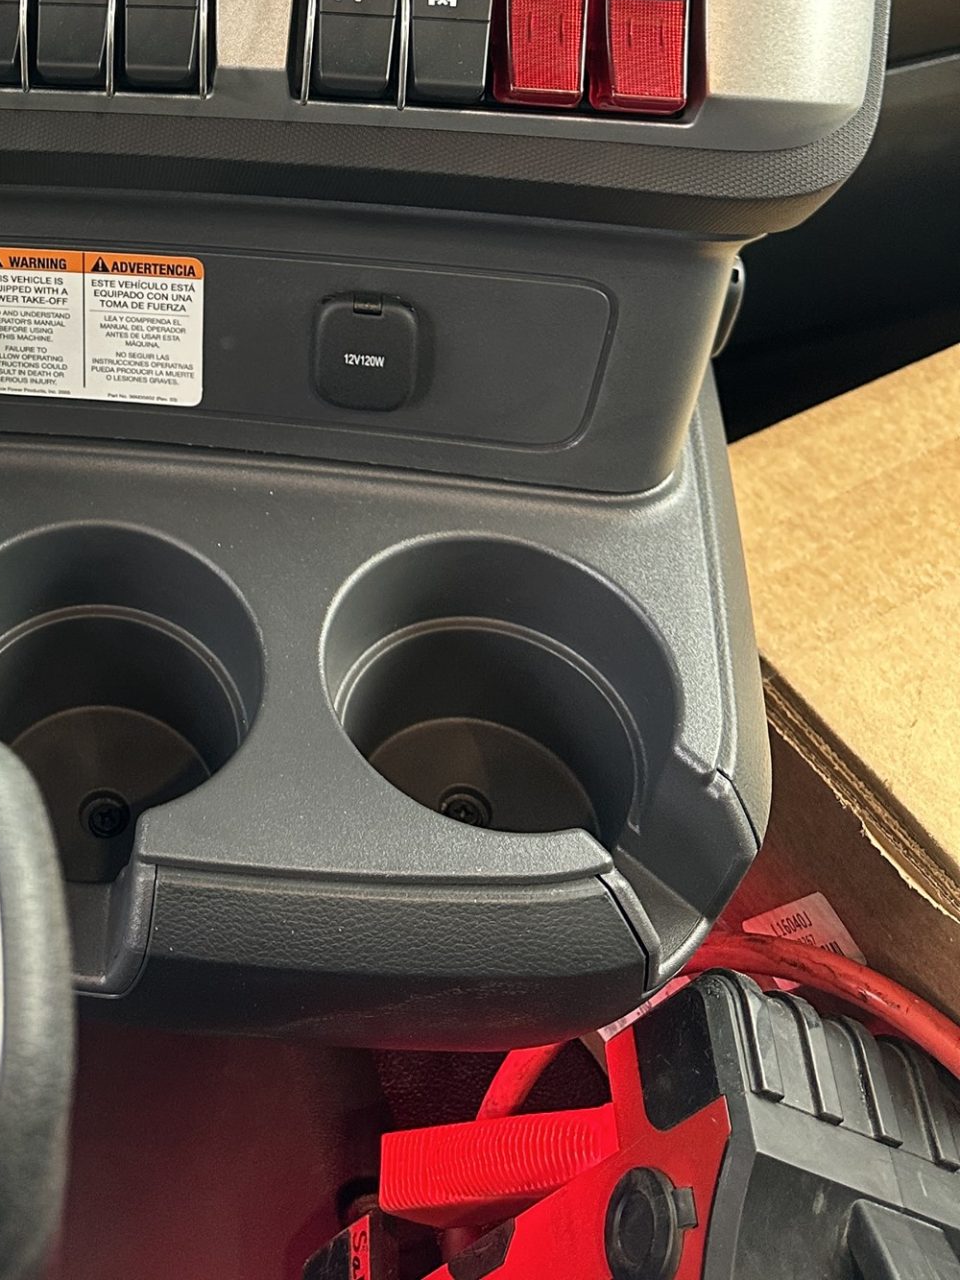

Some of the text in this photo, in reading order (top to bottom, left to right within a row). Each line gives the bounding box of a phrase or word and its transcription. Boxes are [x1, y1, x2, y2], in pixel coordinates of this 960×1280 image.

[9, 256, 66, 269] WARNING
[111, 261, 196, 276] ADVERTENCIA
[11, 276, 50, 284] VEHICLE
[54, 277, 64, 285] IS
[91, 279, 115, 288] ESTE
[118, 280, 168, 290] VEHÍCULO
[34, 286, 58, 295] WITH
[94, 289, 192, 302] EQUIPADO CON UNA
[21, 296, 68, 305] TAKE-OFF
[100, 300, 186, 312] TOMA DE FUERZA
[343, 353, 385, 368] 12V120W
